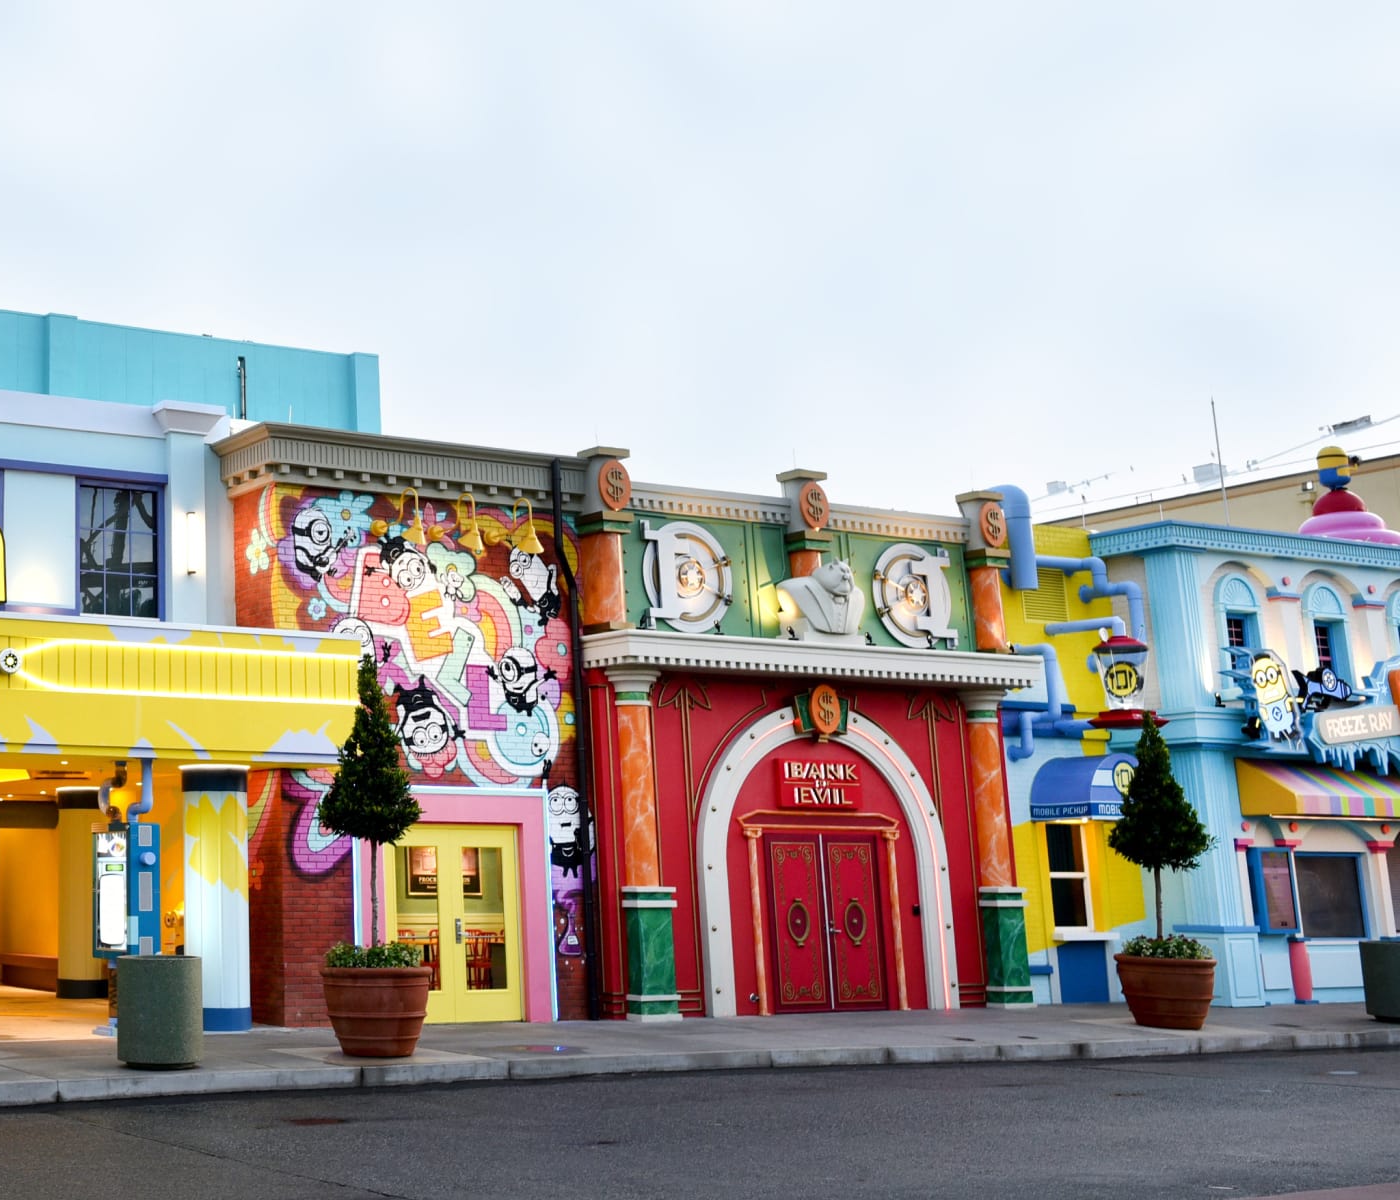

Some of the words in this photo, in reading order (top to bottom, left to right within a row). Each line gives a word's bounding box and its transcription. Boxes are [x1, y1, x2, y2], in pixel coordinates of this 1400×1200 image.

[357, 551, 553, 768] BELLO
[1325, 714, 1369, 738] FREEZE
[1368, 711, 1393, 732] RAY
[783, 761, 859, 780] BANK
[793, 787, 853, 805] EVIL
[1033, 807, 1060, 816] MOBILE
[1062, 805, 1088, 815] PICKUP
